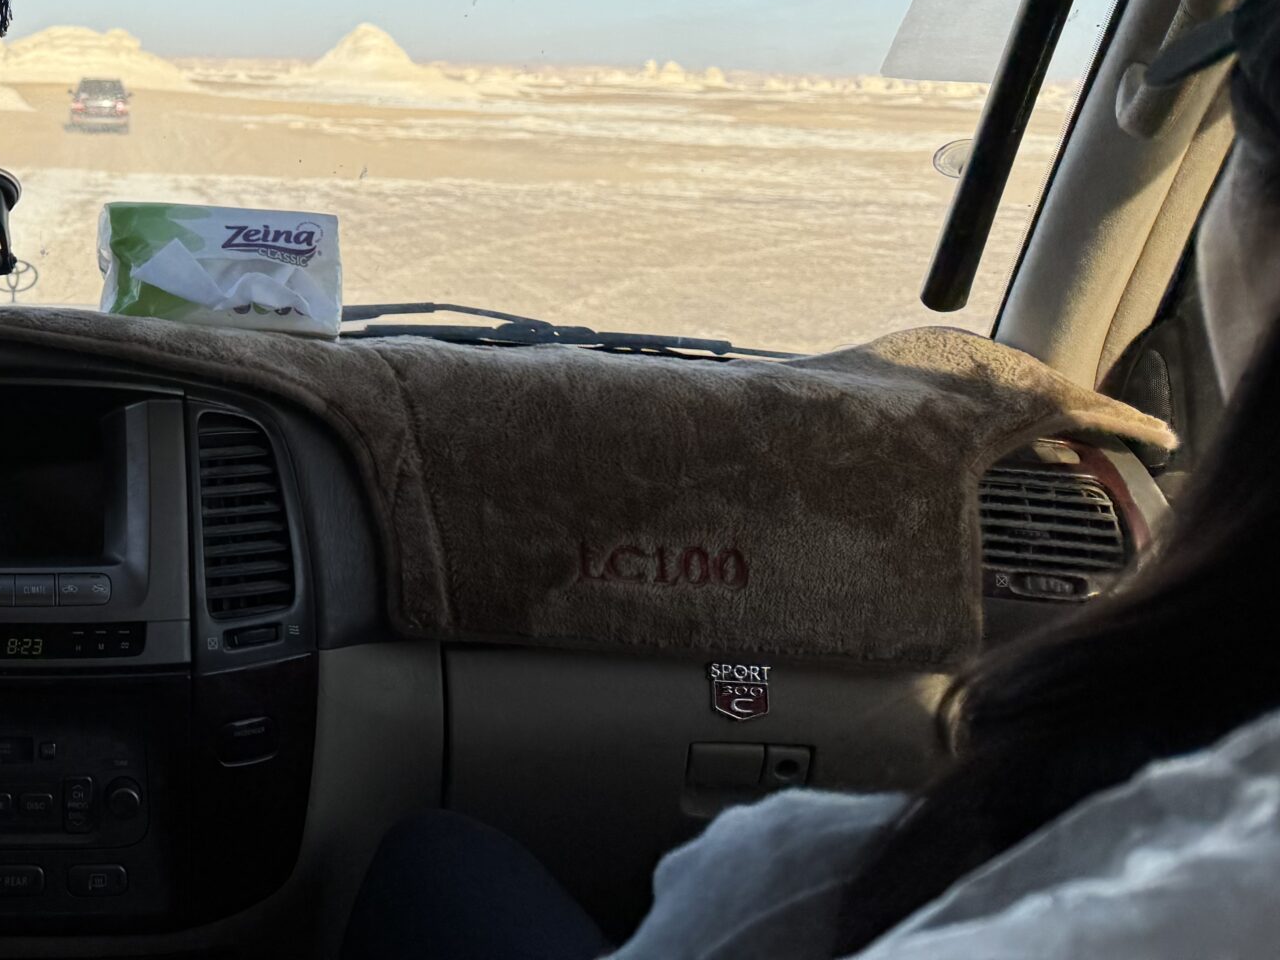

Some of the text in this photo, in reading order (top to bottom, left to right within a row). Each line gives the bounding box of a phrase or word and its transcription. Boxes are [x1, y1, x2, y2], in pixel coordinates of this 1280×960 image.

[221, 224, 316, 250] Zeina
[257, 247, 308, 267] CLASSIC
[577, 541, 748, 590] LC100
[6, 638, 43, 655] 8:23
[710, 663, 772, 681] SPORT
[721, 685, 764, 696] 300
[731, 698, 754, 713] C
[26, 801, 46, 810] DISC
[3, 876, 28, 887] REAR
